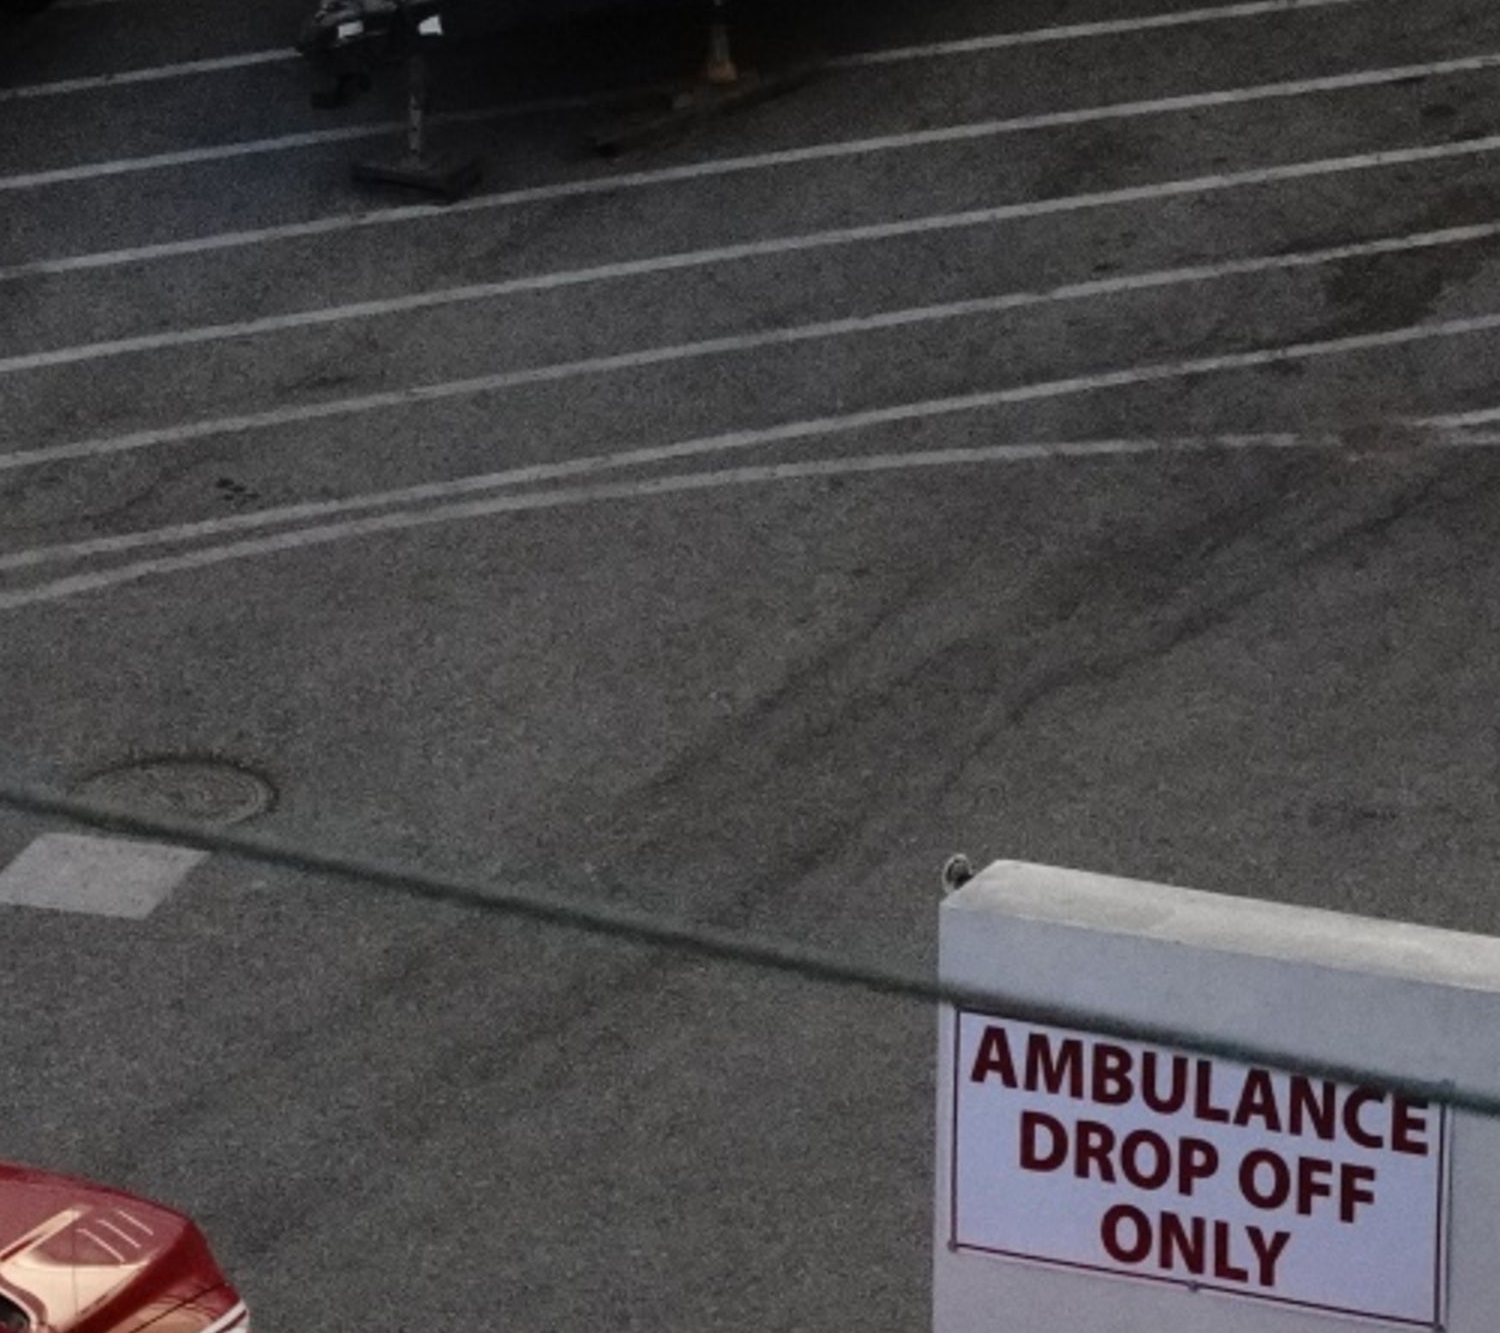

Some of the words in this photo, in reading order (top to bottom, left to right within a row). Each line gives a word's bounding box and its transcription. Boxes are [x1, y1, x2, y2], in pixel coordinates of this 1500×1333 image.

[971, 1025, 1429, 1157] AMBULANCE
[1019, 1111, 1219, 1197] DROP
[1238, 1149, 1376, 1223] OFF
[1100, 1204, 1291, 1287] ONLY
